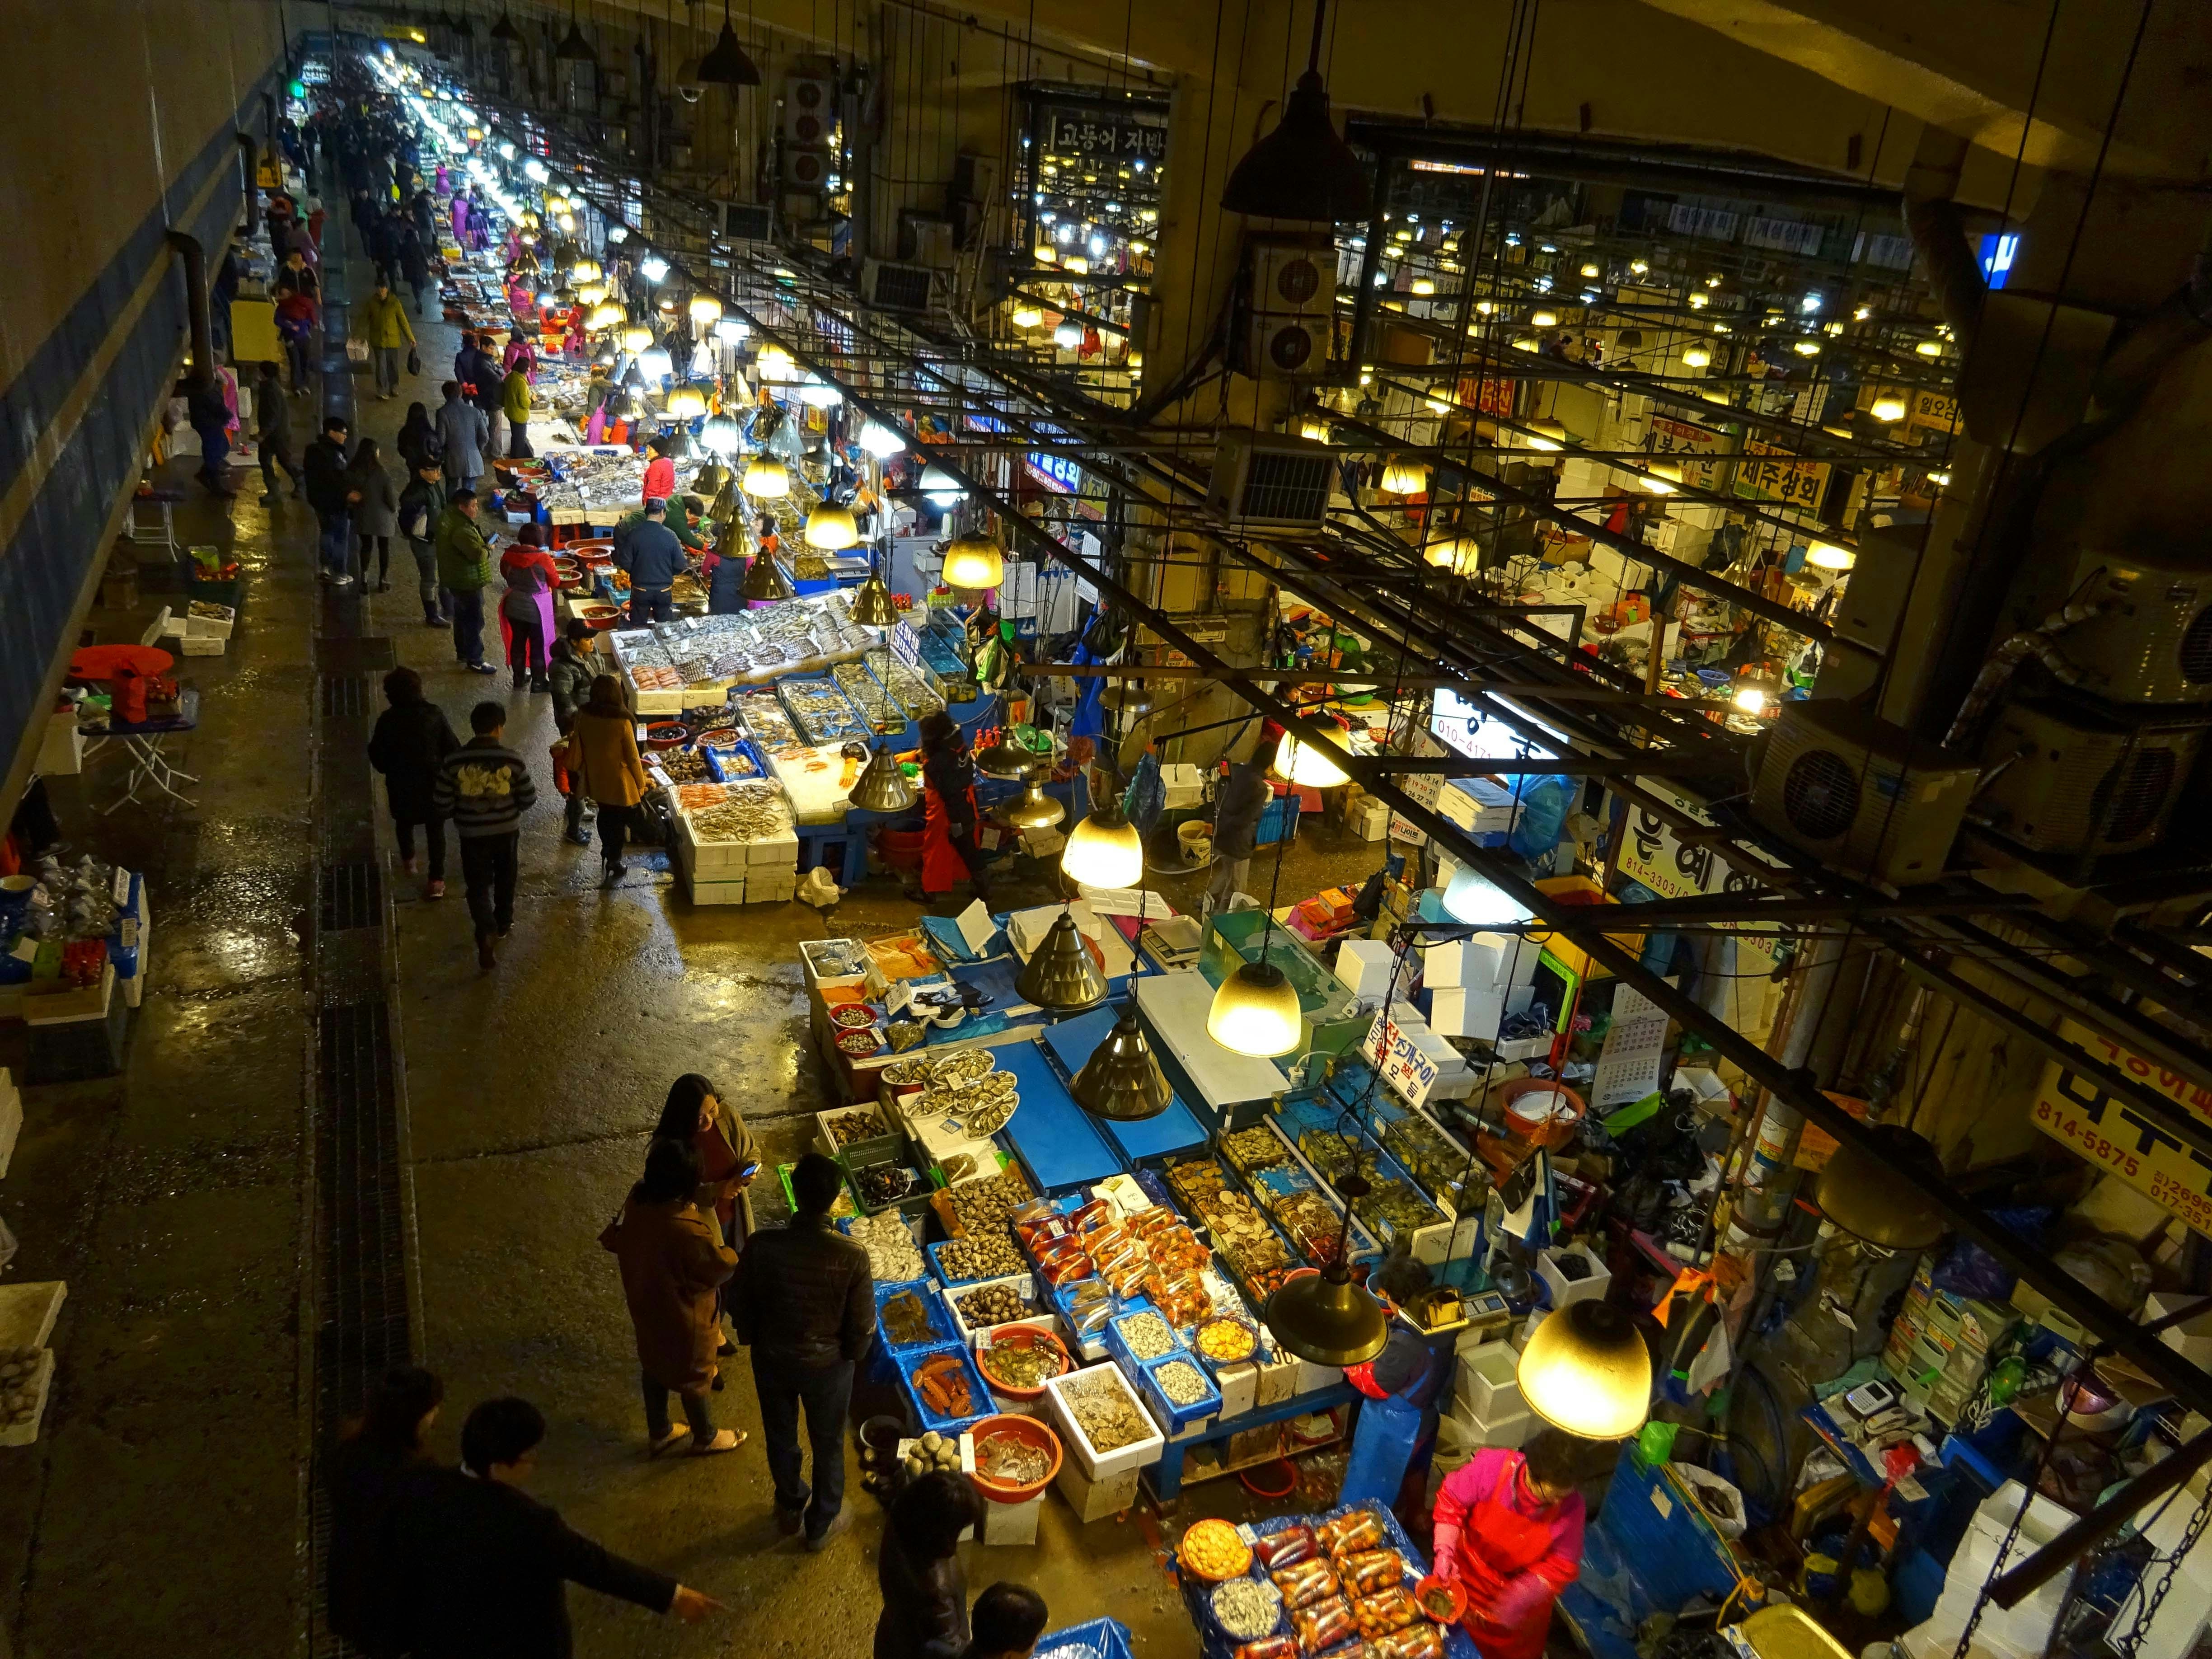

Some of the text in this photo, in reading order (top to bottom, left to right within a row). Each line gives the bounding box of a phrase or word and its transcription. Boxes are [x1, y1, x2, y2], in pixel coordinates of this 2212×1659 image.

[1058, 123, 1117, 152] 고등어
[1393, 1036, 1436, 1089] 조개구이
[2037, 1101, 2140, 1177] 814-5875
